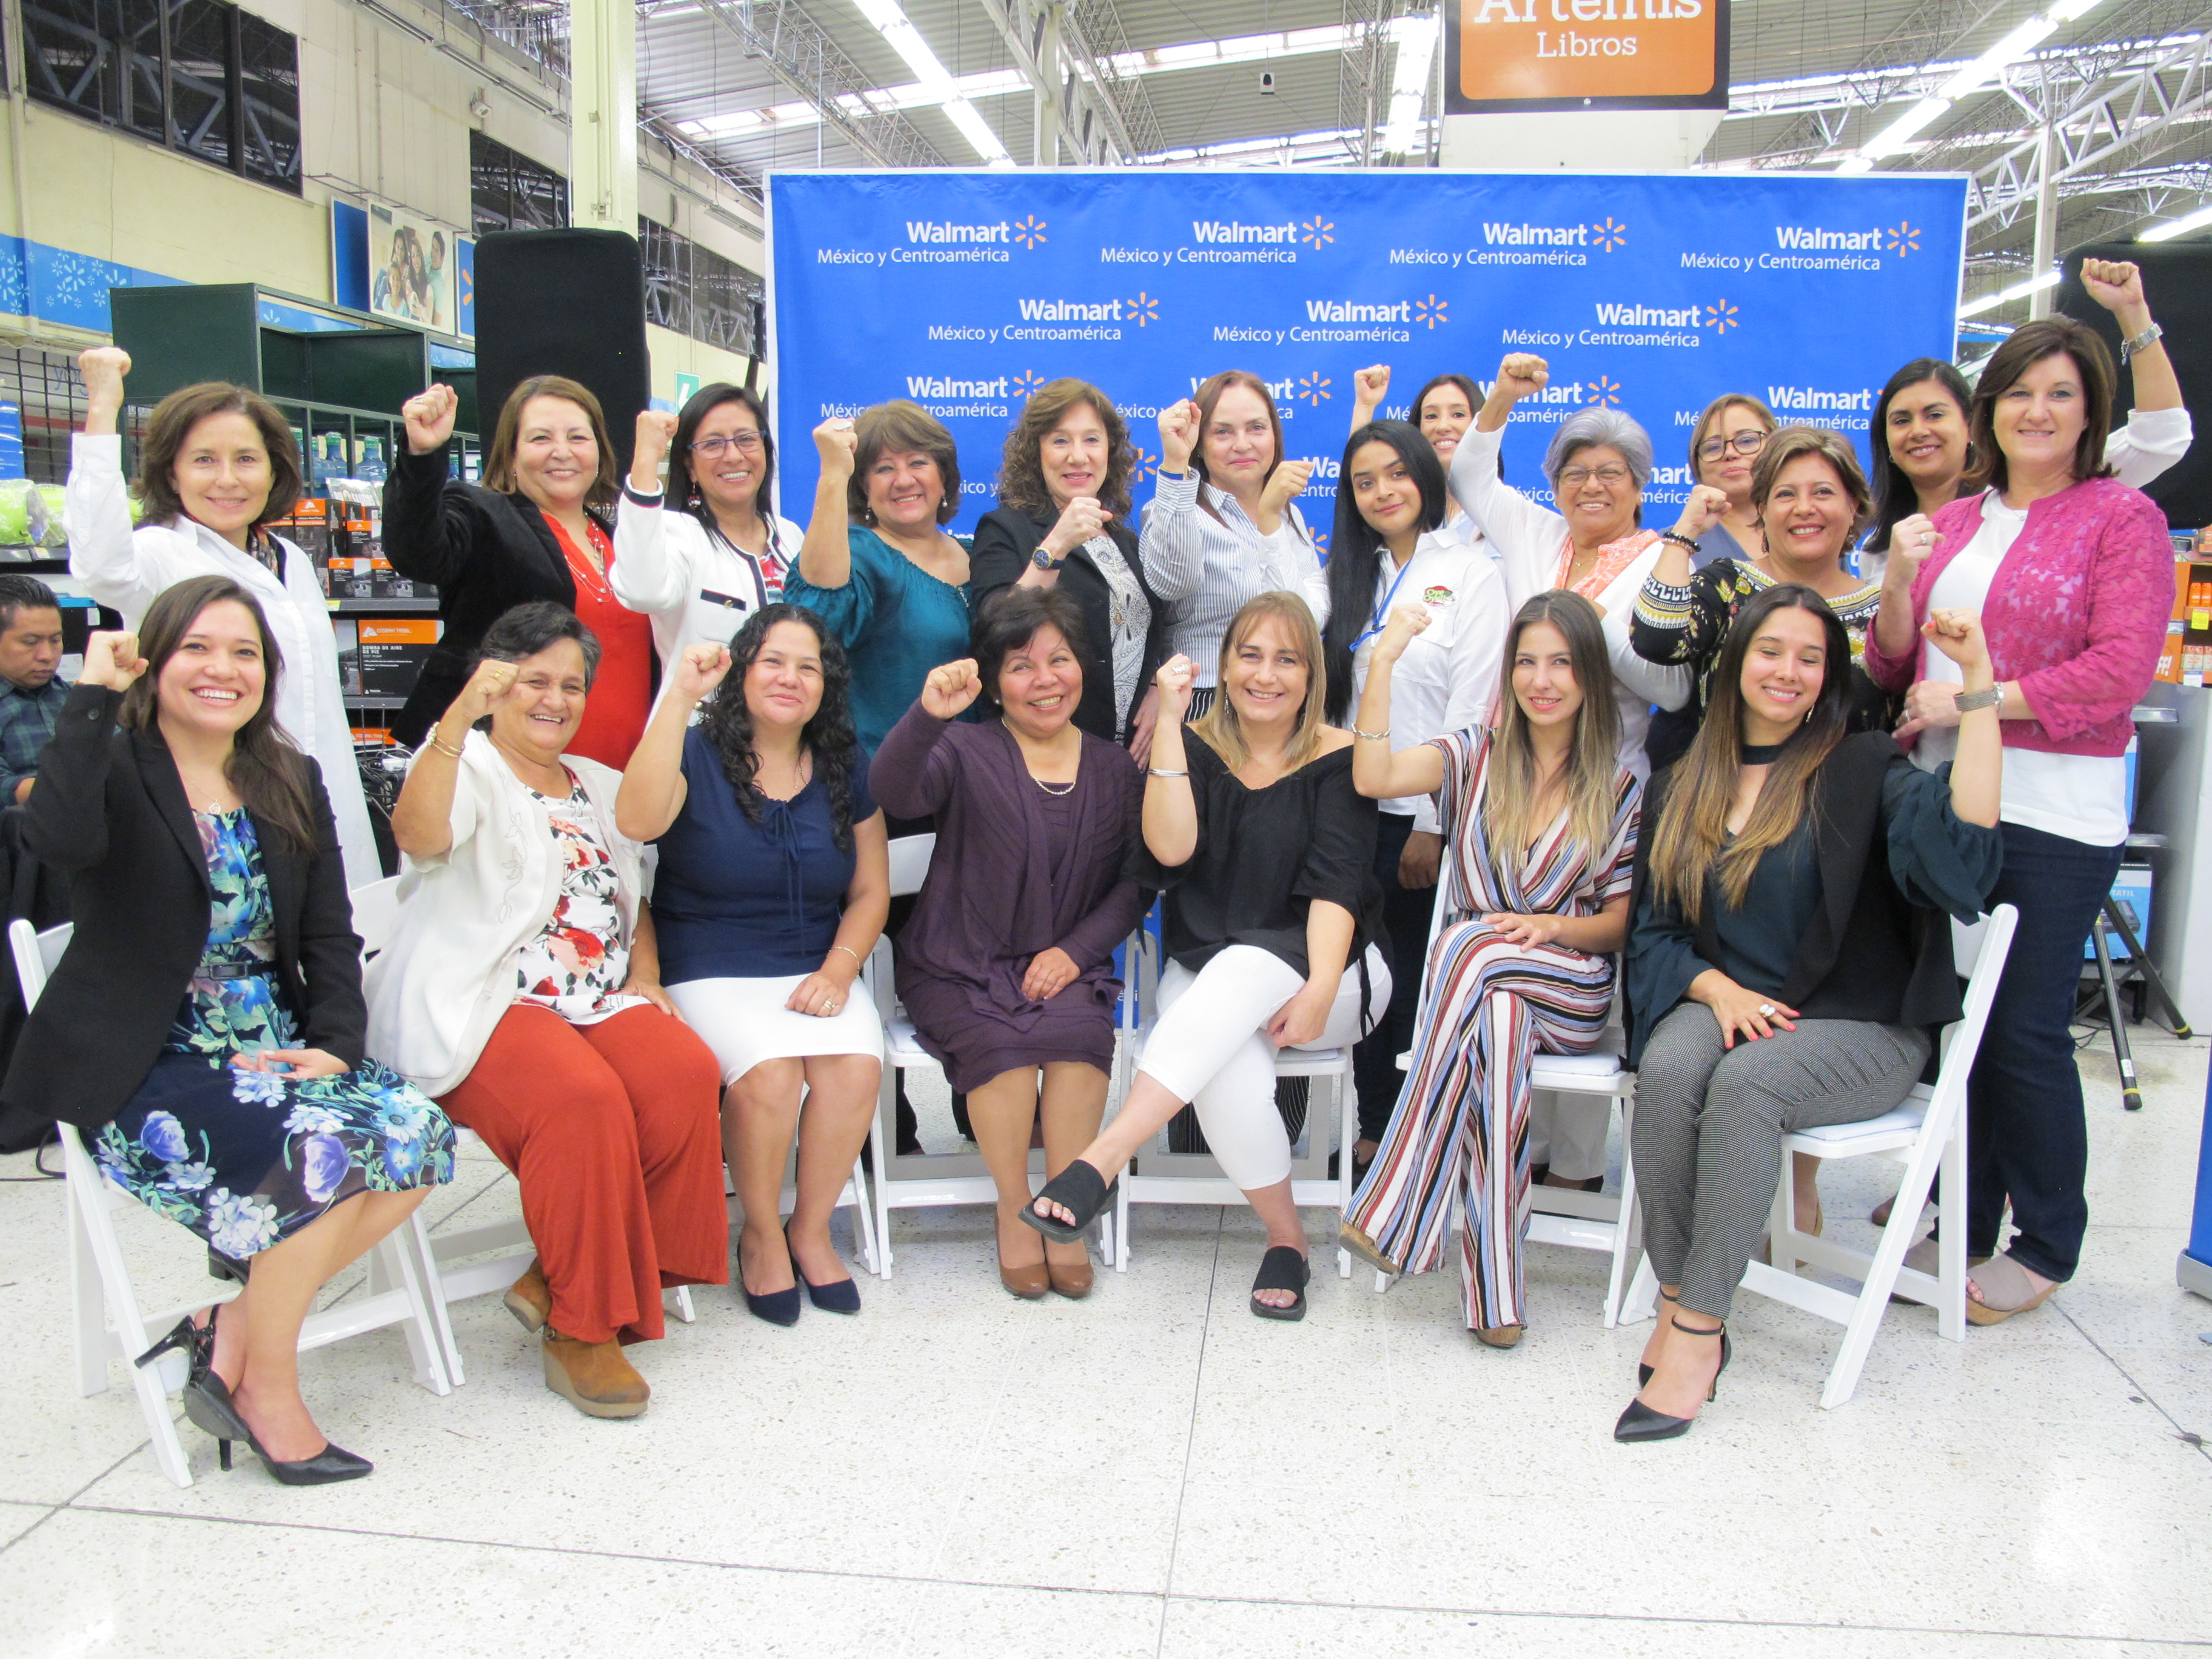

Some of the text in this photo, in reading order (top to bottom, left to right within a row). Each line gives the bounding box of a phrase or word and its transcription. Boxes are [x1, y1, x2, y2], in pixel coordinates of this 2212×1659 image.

[1537, 30, 1637, 57] Libros
[907, 221, 1010, 243] Walmart
[1193, 221, 1297, 243] Walmart
[1483, 223, 1587, 246] Walmart
[1777, 227, 1882, 250] Walmart
[819, 247, 1009, 266] México y Centroamérica
[1102, 247, 1296, 266] México y Centroamérica
[1390, 249, 1586, 267] México y Centroamérica
[1681, 253, 1880, 272] México y Centroamérica
[1019, 299, 1121, 320] Walmart
[1306, 301, 1410, 322] Walmart
[1596, 304, 1700, 327] Walmart
[929, 325, 1121, 343] México y Centroamérica
[1215, 326, 1409, 345] México y Centroamérica
[1503, 330, 1699, 348] México y Centroamérica
[907, 377, 1008, 398] Walmart
[1768, 386, 1871, 411] Walmart
[821, 402, 1008, 418] Méxic troamérica
[1116, 403, 1156, 420] éxico
[1777, 414, 1869, 431] ntroamérica
[2156, 655, 2173, 676] FF!
